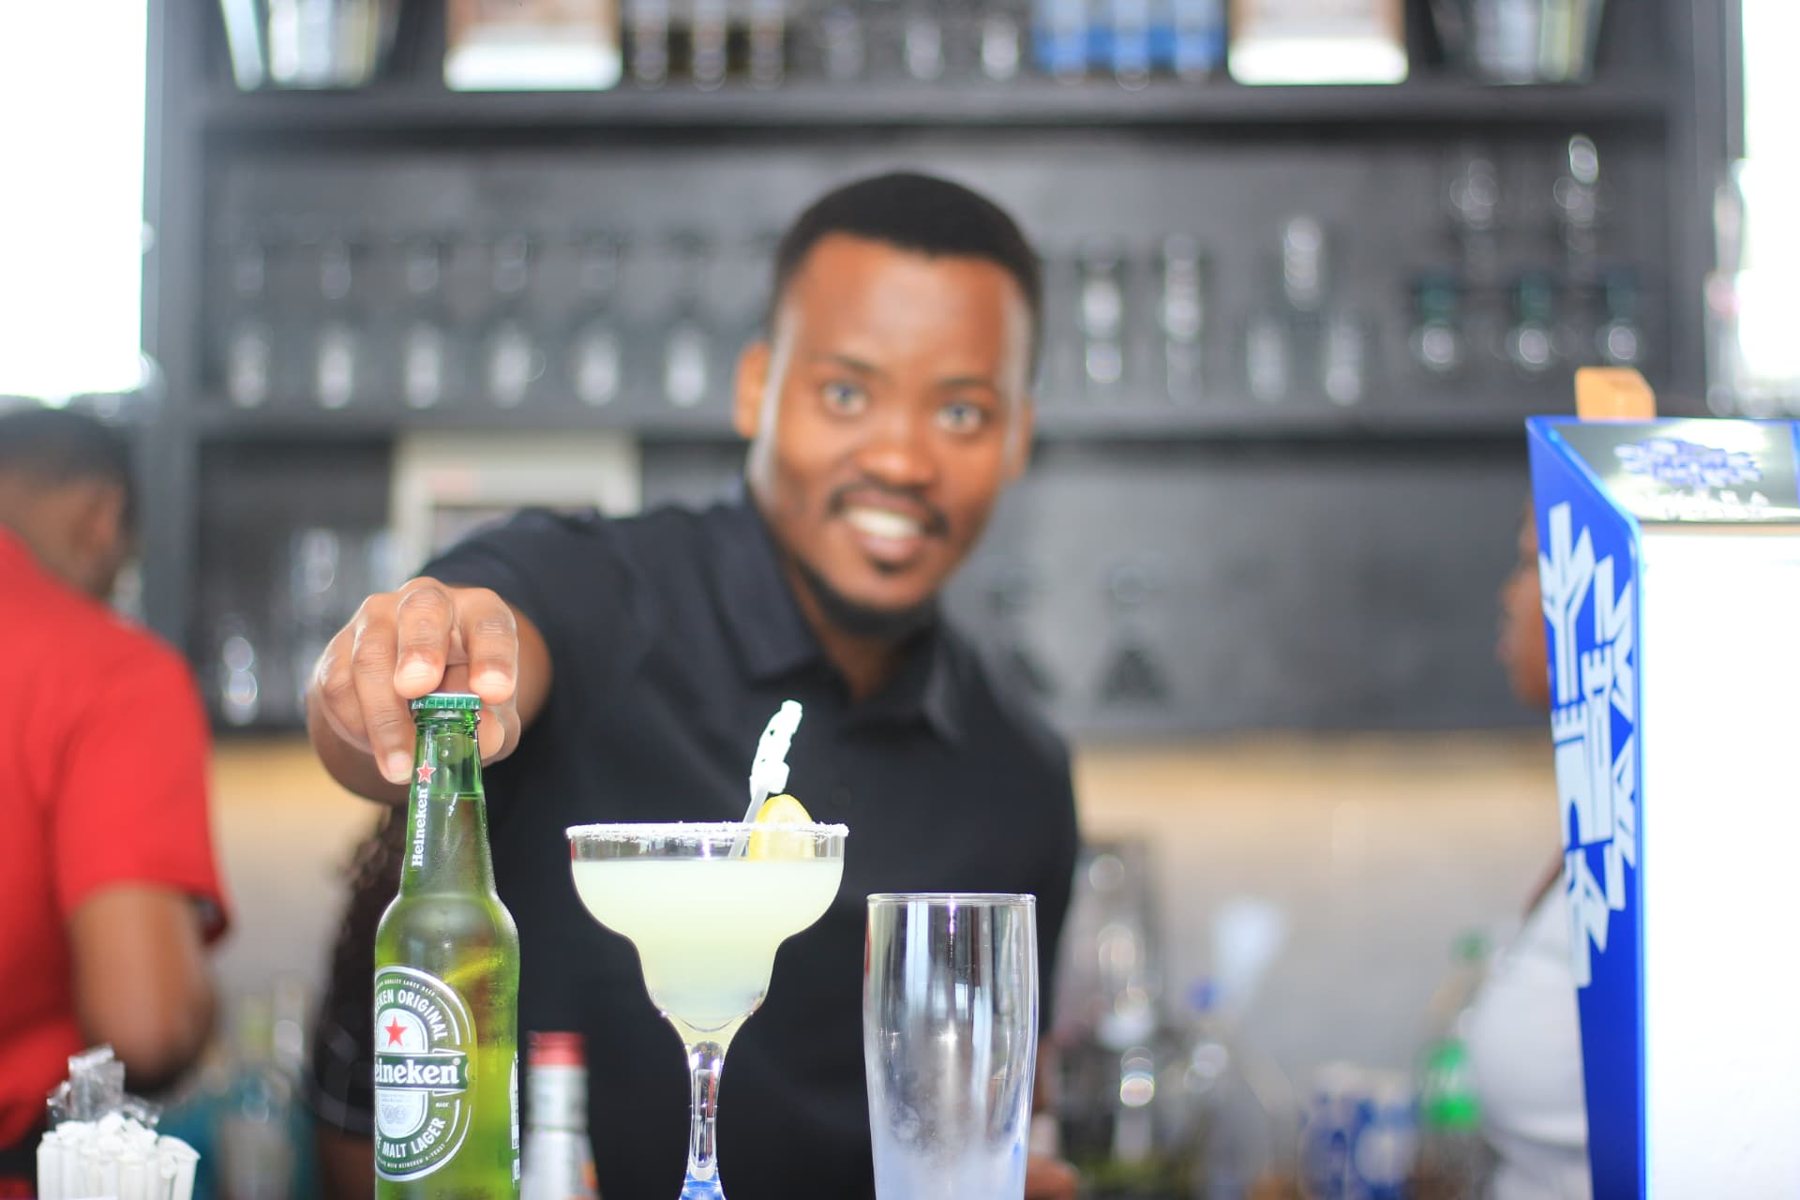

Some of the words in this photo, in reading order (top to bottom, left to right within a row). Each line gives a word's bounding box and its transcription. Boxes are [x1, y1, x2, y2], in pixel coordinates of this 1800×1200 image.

[412, 789, 428, 867] Heineken
[398, 989, 448, 1041] ORIGINAL
[375, 1057, 460, 1085] eineken
[382, 1141, 406, 1158] MALT
[411, 1117, 446, 1154] LAGER
